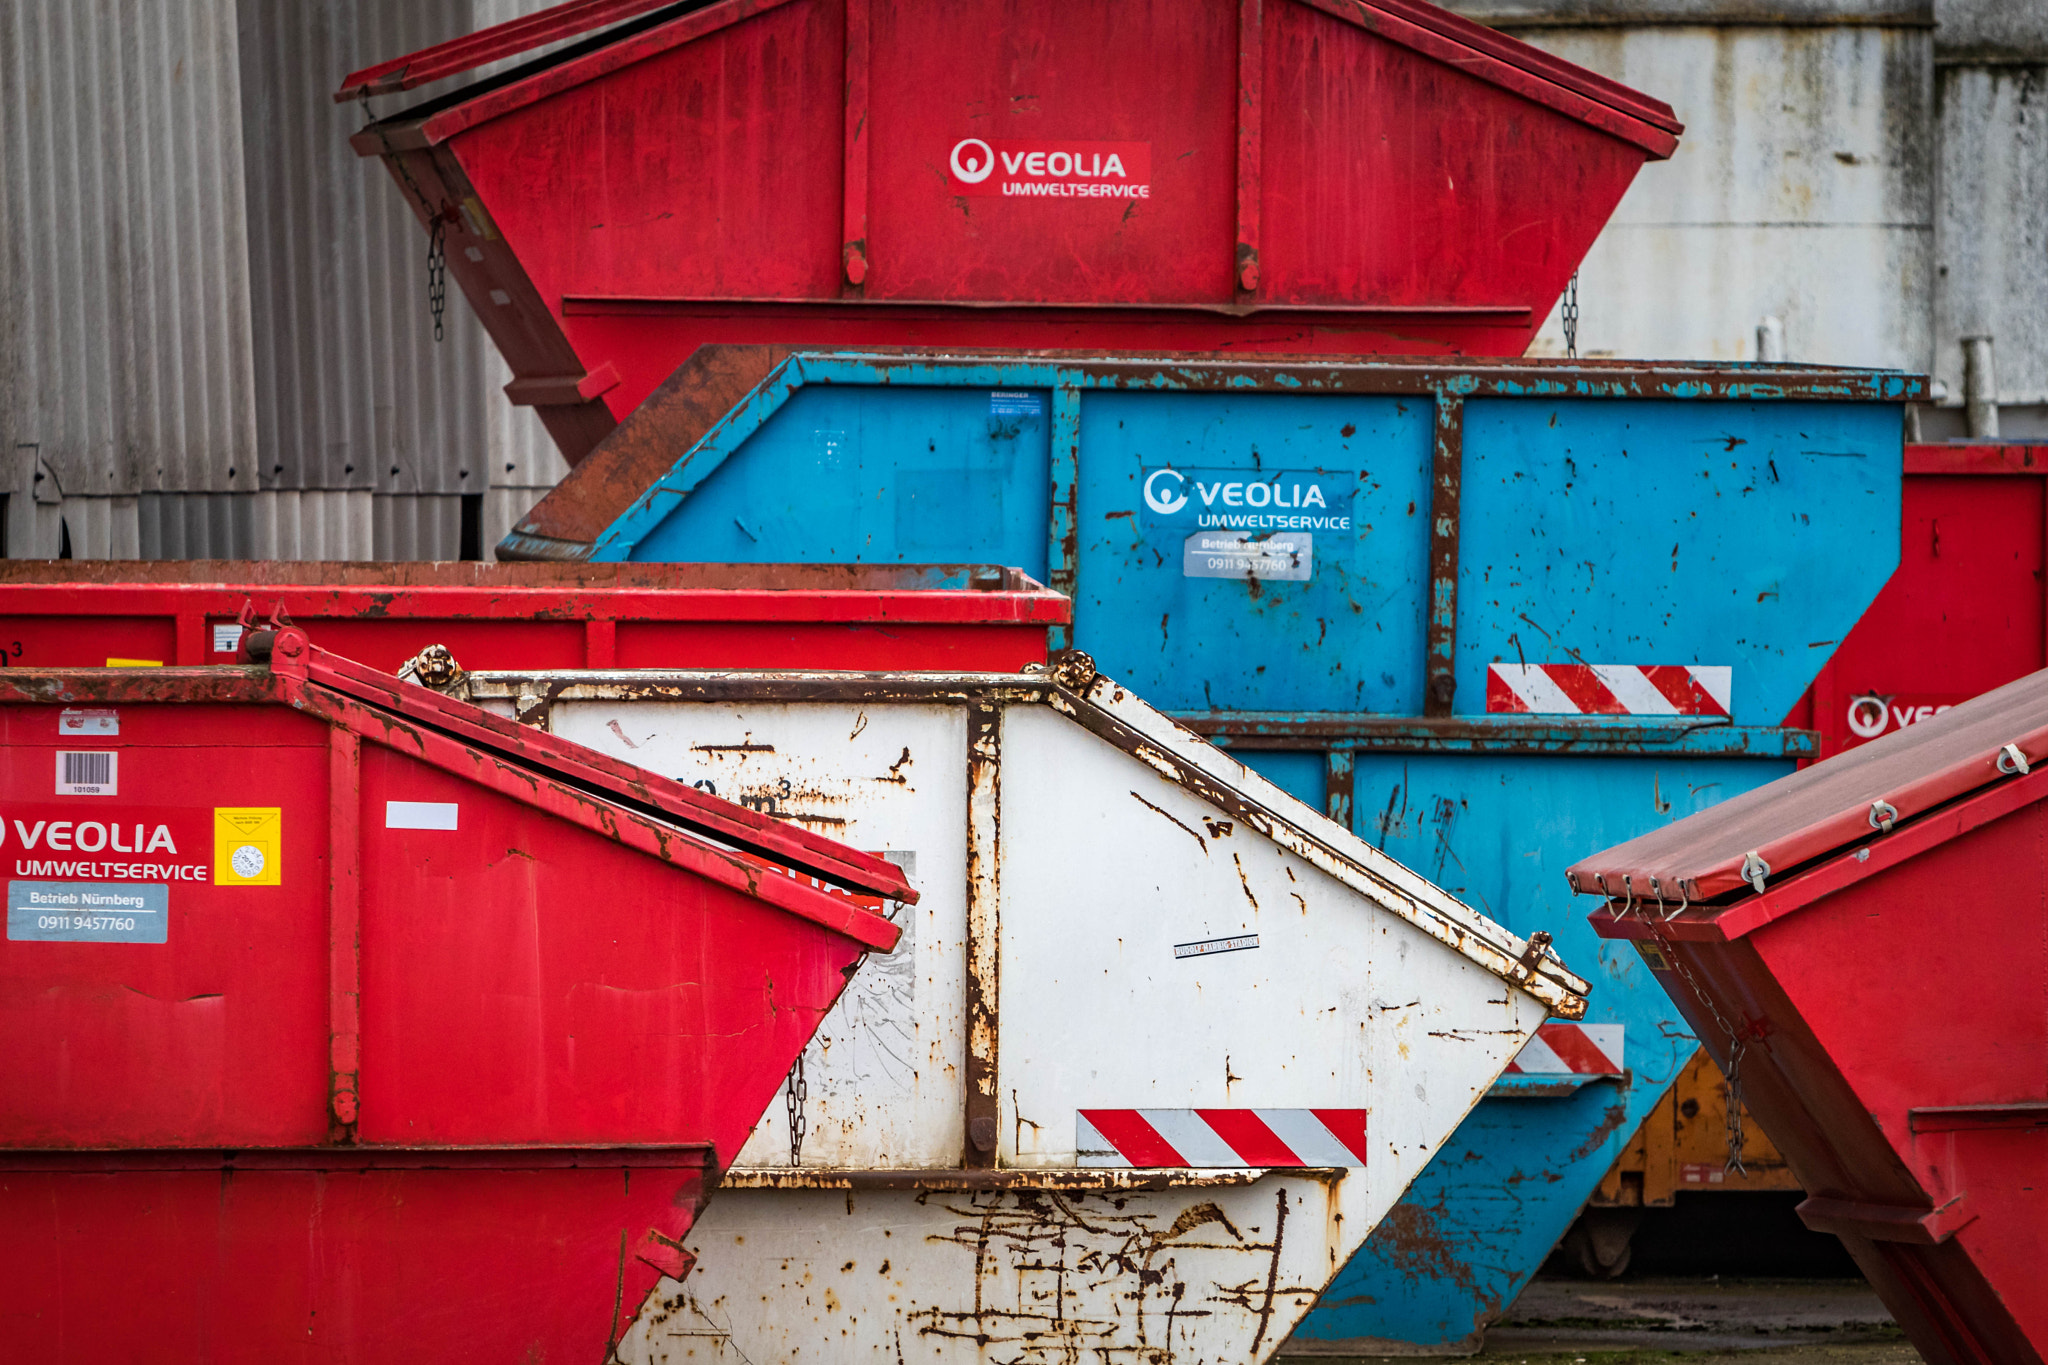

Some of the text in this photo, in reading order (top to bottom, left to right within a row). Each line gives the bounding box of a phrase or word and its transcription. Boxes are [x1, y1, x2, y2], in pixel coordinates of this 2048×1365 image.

[1001, 151, 1126, 177] VEOLIA
[1002, 182, 1150, 197] UMWELTSERVICE
[1196, 482, 1327, 508] VEOLIA
[1198, 514, 1350, 529] UMWELTSERVICE
[1201, 538, 1241, 549] Betrieb
[1207, 557, 1233, 569] 0911
[1893, 705, 1954, 728] VE
[13, 820, 178, 855] VEOLIA
[15, 859, 208, 881] UMWELTSERVICE
[30, 892, 145, 909] Betrieb Nürnberg
[38, 915, 135, 931] 0911 9457760
